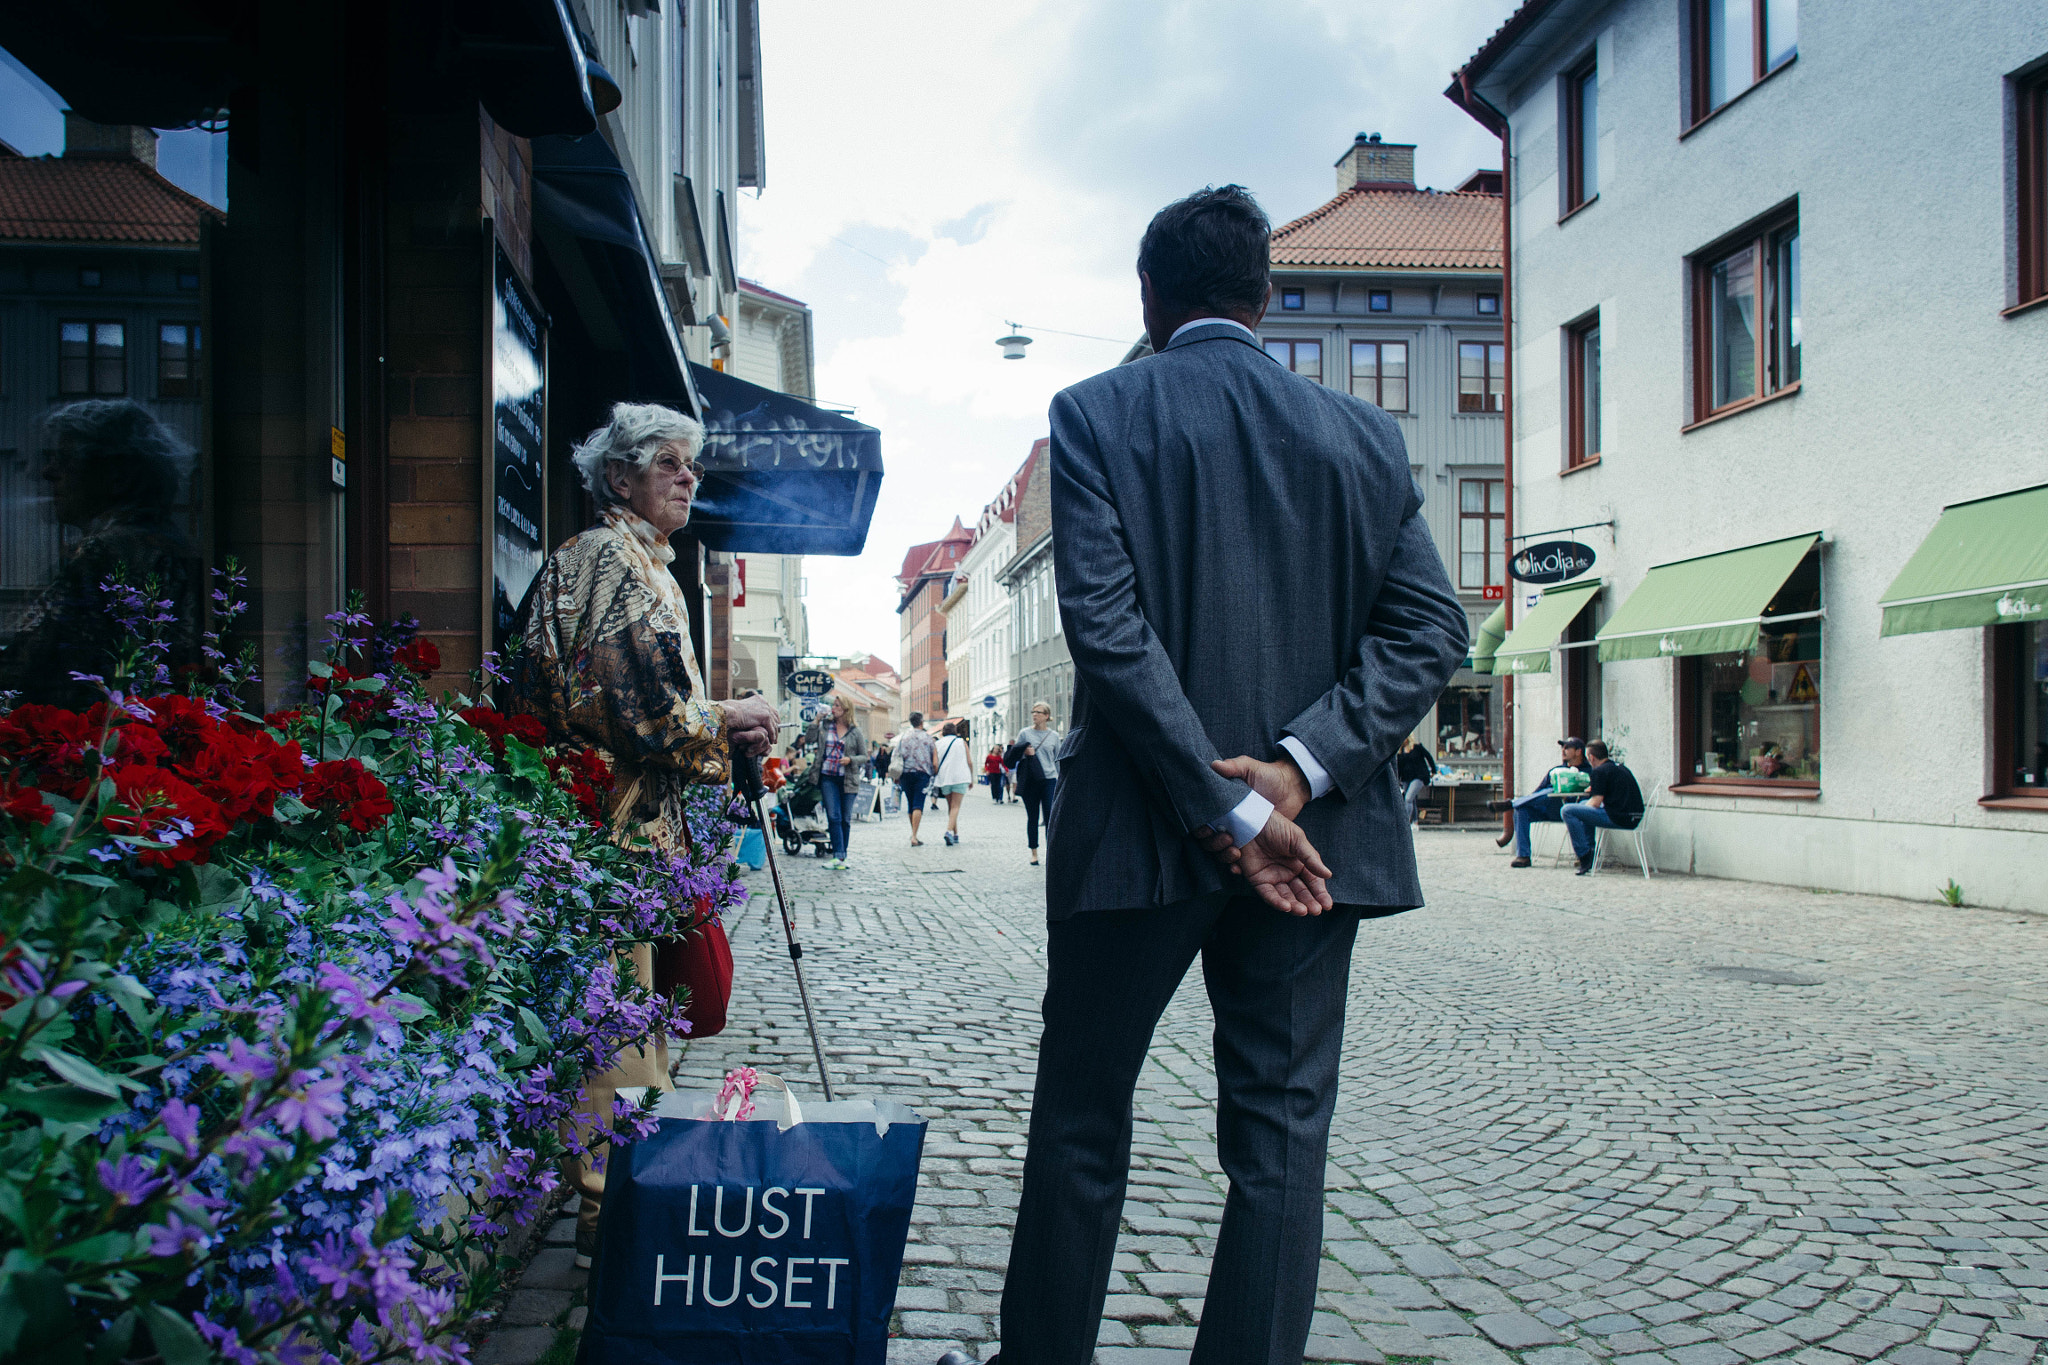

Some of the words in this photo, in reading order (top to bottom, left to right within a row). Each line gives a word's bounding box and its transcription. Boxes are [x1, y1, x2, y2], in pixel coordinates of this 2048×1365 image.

[795, 674, 824, 685] CAFÉ
[688, 1184, 826, 1239] LUST
[654, 1254, 849, 1309] HUSET
